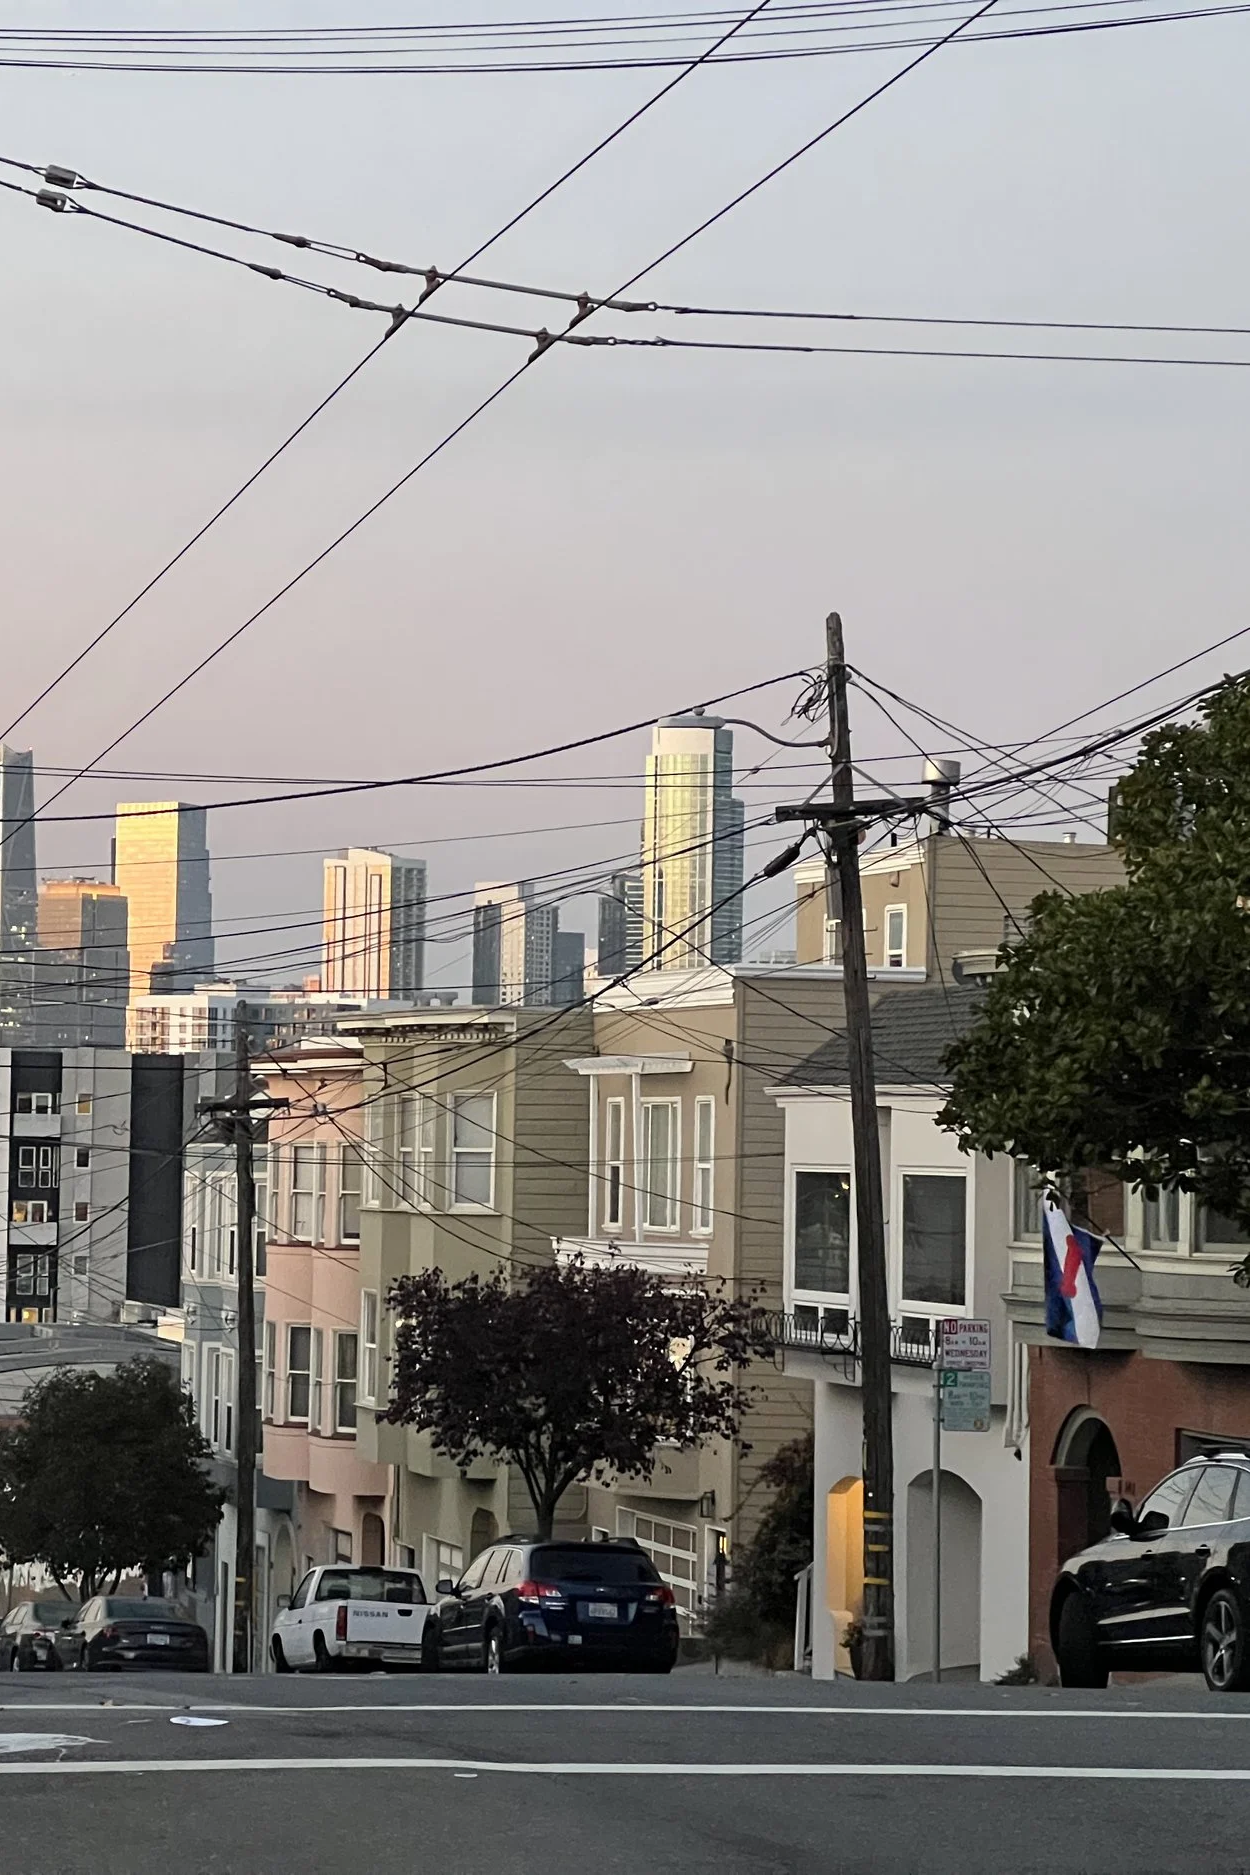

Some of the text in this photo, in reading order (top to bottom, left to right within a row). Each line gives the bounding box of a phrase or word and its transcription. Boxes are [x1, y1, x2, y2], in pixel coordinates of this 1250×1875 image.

[944, 1320, 988, 1334] NO PARKING
[945, 1349, 987, 1358] WEDNESDAY
[946, 1372, 956, 1386] 2
[353, 1610, 389, 1618] NISSAN
